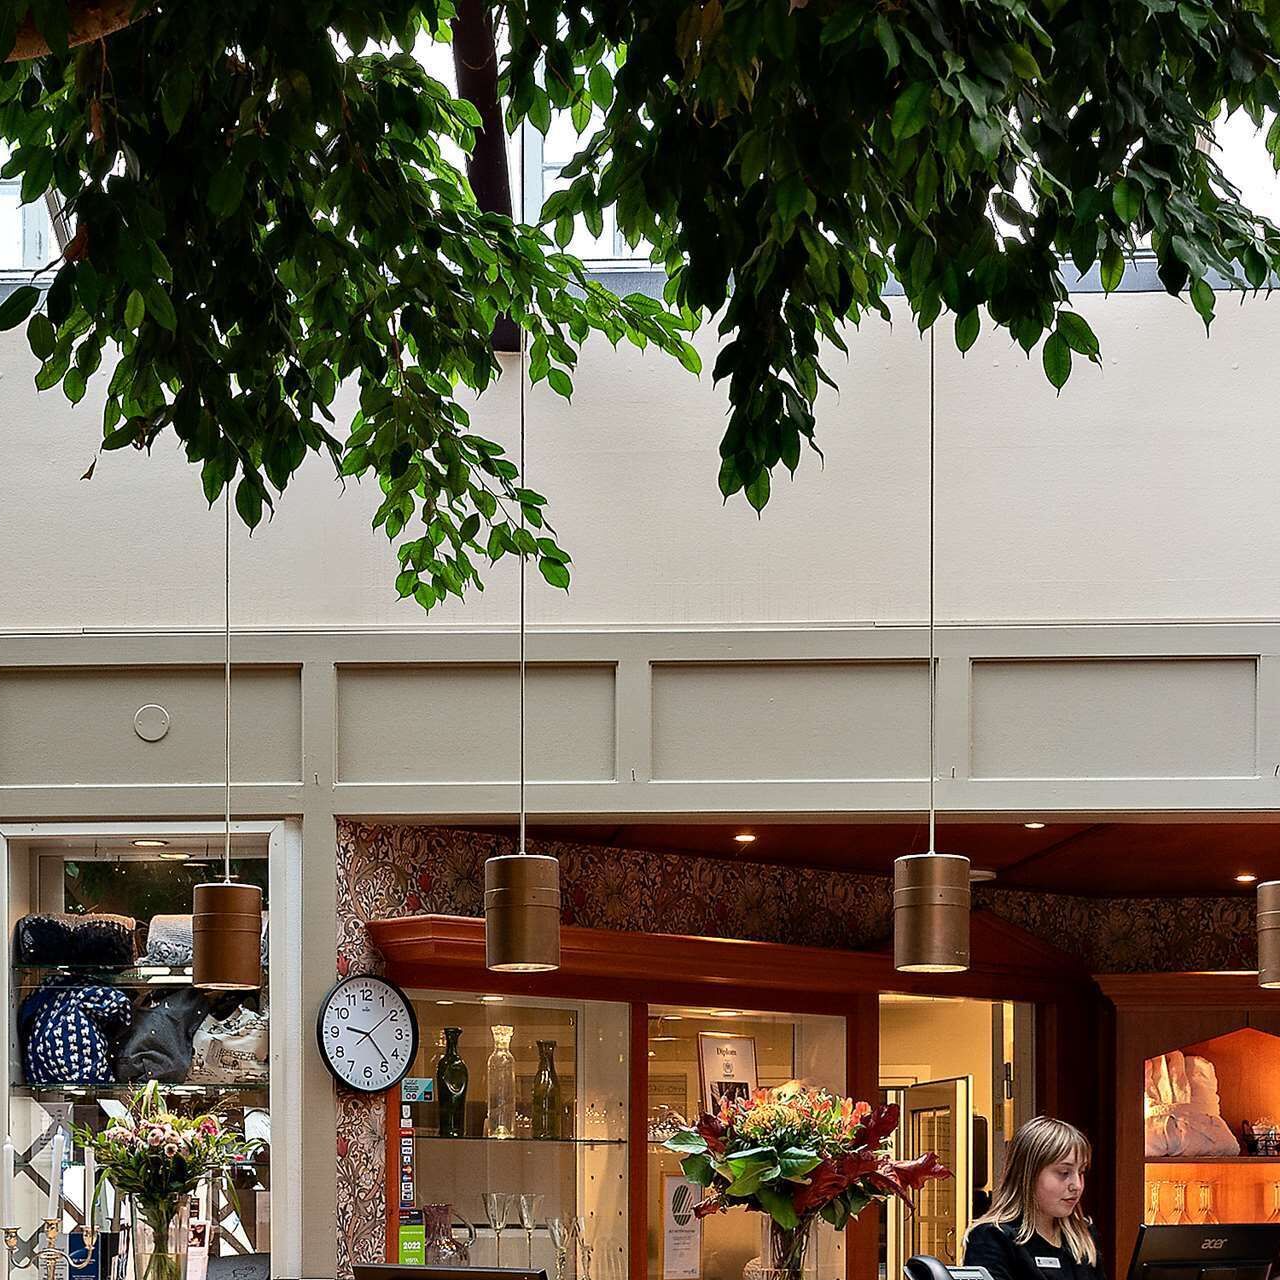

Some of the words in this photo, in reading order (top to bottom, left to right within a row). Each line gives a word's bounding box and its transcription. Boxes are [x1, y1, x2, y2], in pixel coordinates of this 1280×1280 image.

[346, 994, 356, 1006] 11
[360, 989, 373, 1001] 12
[379, 996, 385, 1007] 1
[334, 1007, 349, 1019] 10
[390, 1010, 398, 1021] 2
[330, 1026, 339, 1038] 9
[395, 1029, 403, 1040] 3
[335, 1046, 344, 1058] 8
[391, 1048, 399, 1059] 4
[347, 1060, 355, 1072] 7
[380, 1061, 389, 1073] 5
[363, 1067, 372, 1078] 6
[403, 1241, 420, 1249] 2022
[1201, 1237, 1228, 1249] acer
